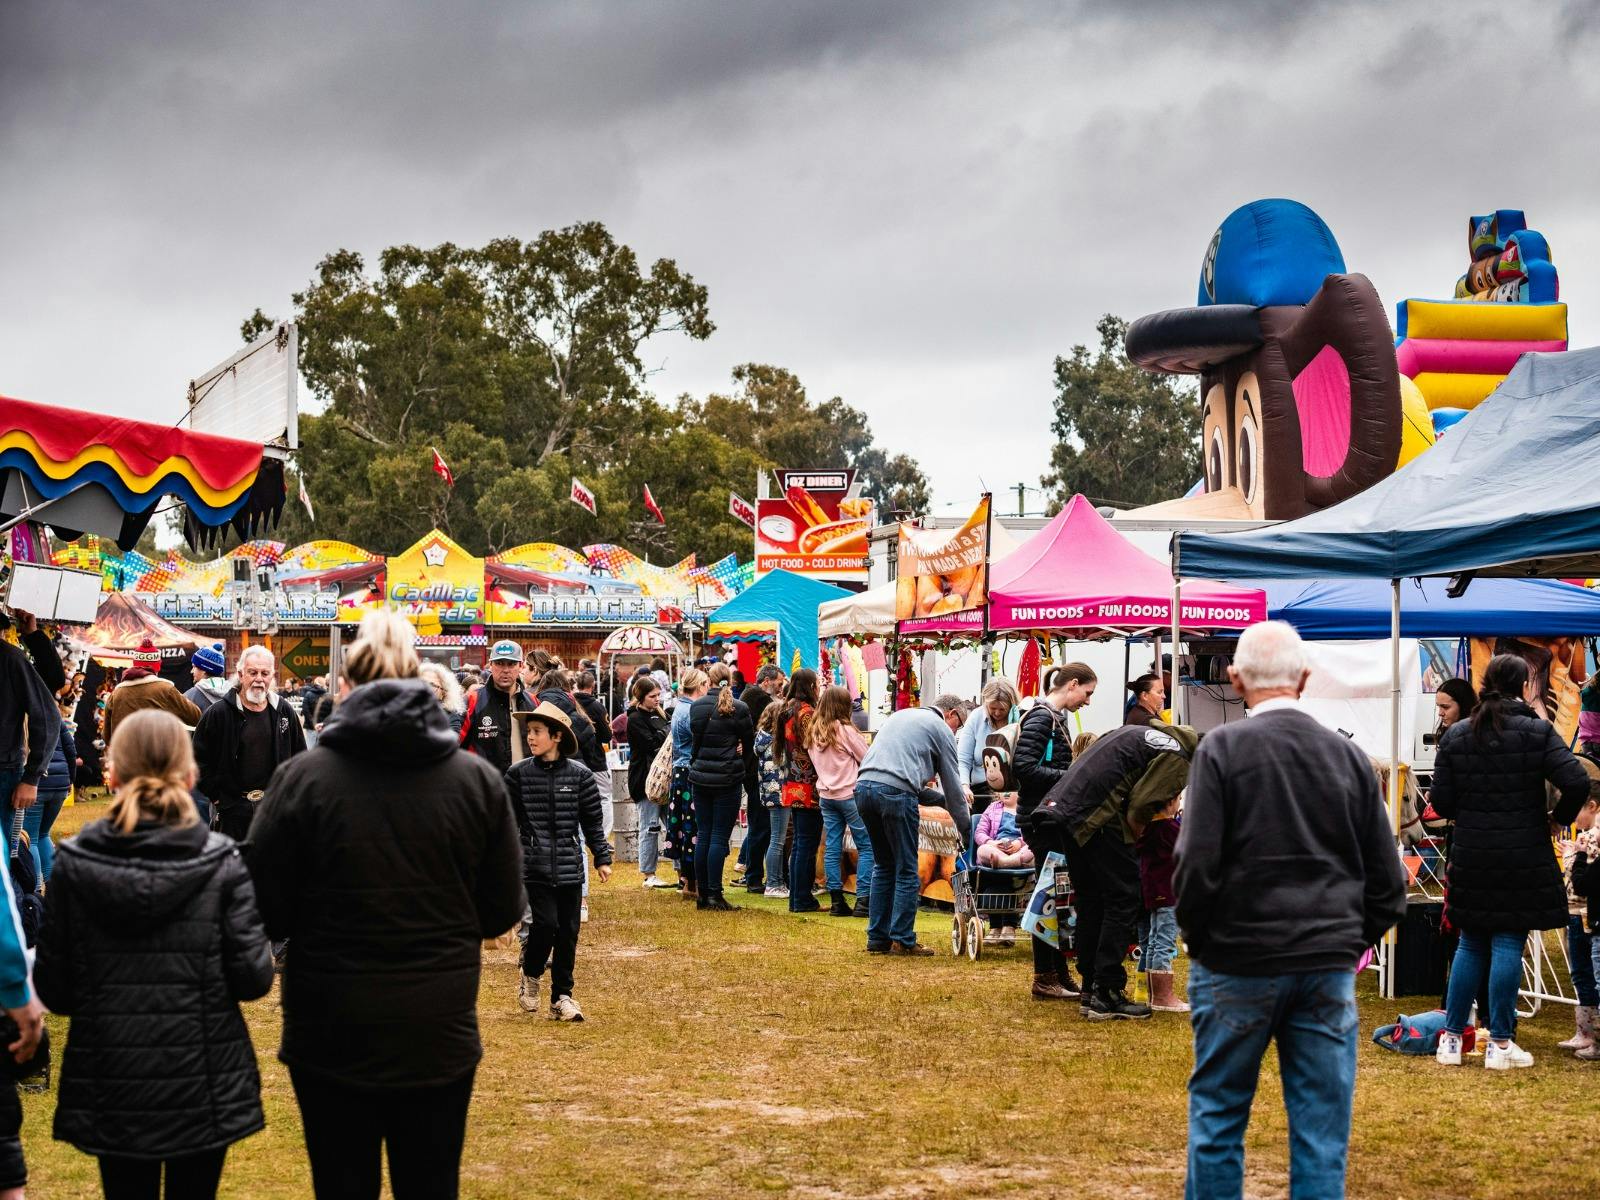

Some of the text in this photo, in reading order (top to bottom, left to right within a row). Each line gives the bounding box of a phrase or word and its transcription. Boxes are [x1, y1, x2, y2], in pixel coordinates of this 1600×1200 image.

[806, 477, 842, 487] DINER
[945, 540, 961, 552] on
[960, 536, 974, 546] a
[761, 558, 864, 568] HOT FOOD COLD DRINK
[932, 554, 964, 573] MADE
[391, 582, 481, 602] Cadillac
[270, 591, 338, 620] ARS
[1011, 603, 1169, 620] FUN FOODS FUN FOODS
[1182, 607, 1251, 621] FUN FOODS
[606, 626, 668, 651] EXIT
[292, 655, 332, 666] ONE W
